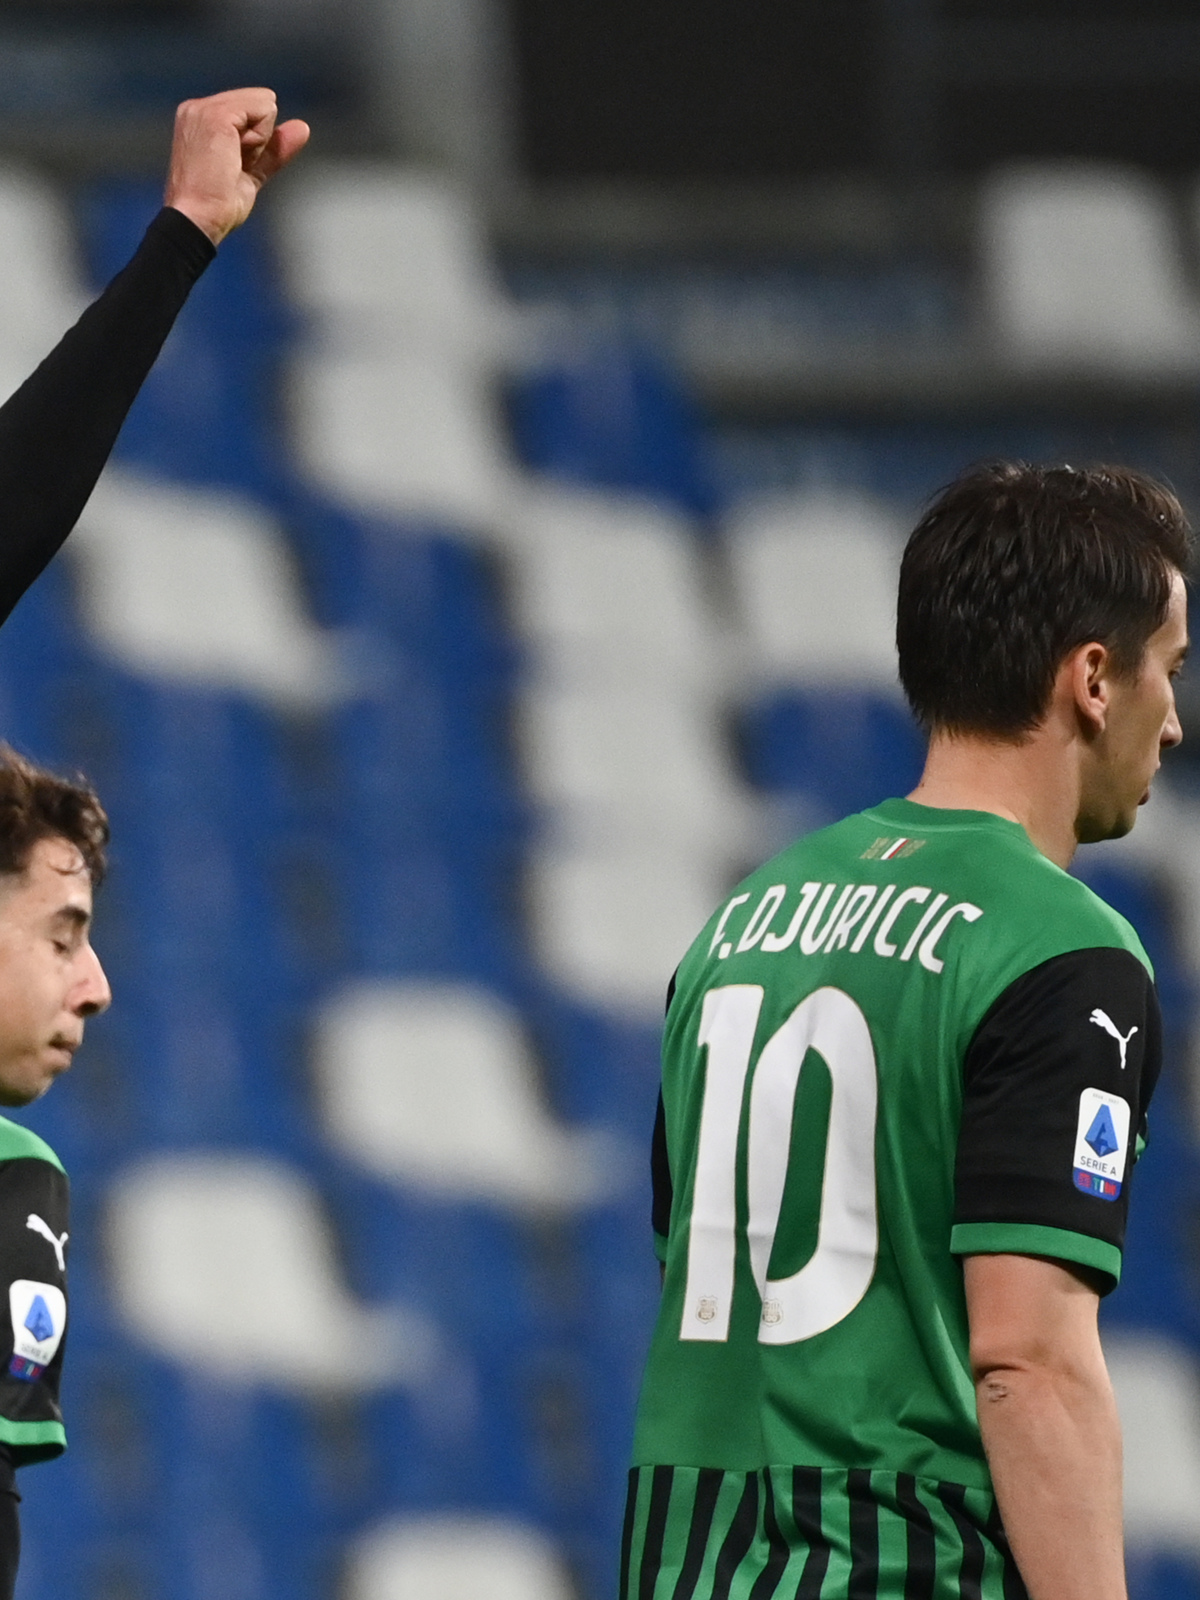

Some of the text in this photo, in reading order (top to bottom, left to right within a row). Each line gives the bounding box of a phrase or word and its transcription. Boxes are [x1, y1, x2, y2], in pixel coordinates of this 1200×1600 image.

[679, 984, 878, 1345] 10
[1080, 1155, 1117, 1176] SERIE A
